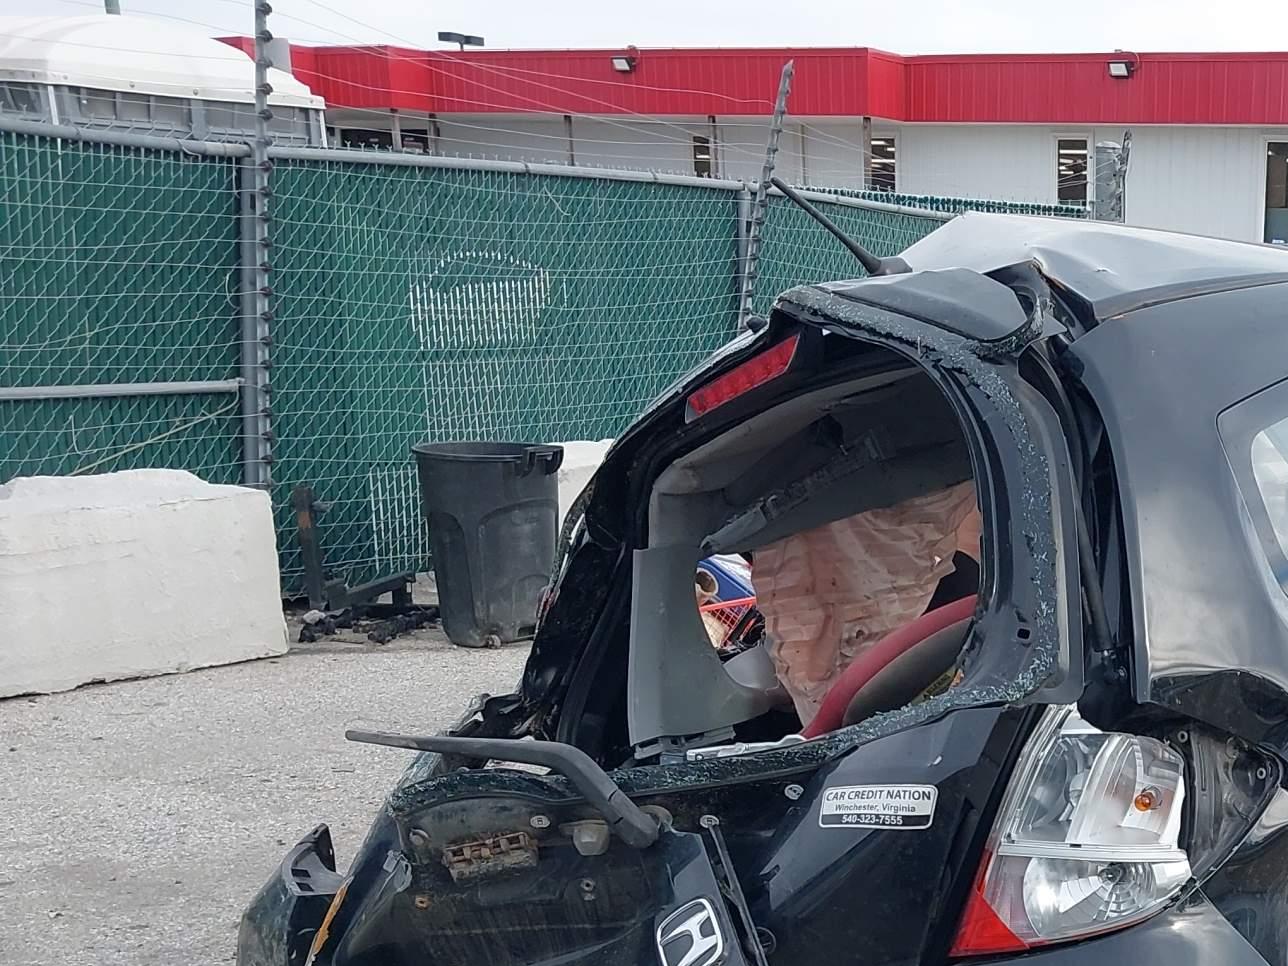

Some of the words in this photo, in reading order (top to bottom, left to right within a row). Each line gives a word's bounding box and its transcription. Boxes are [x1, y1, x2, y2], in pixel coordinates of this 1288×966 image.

[826, 791, 846, 802] CAR
[847, 789, 884, 801] CREDIT
[886, 789, 931, 801] NATION
[834, 803, 880, 813] Winchester,
[882, 803, 916, 813] Virginia
[842, 814, 903, 825] 540-323-7555
